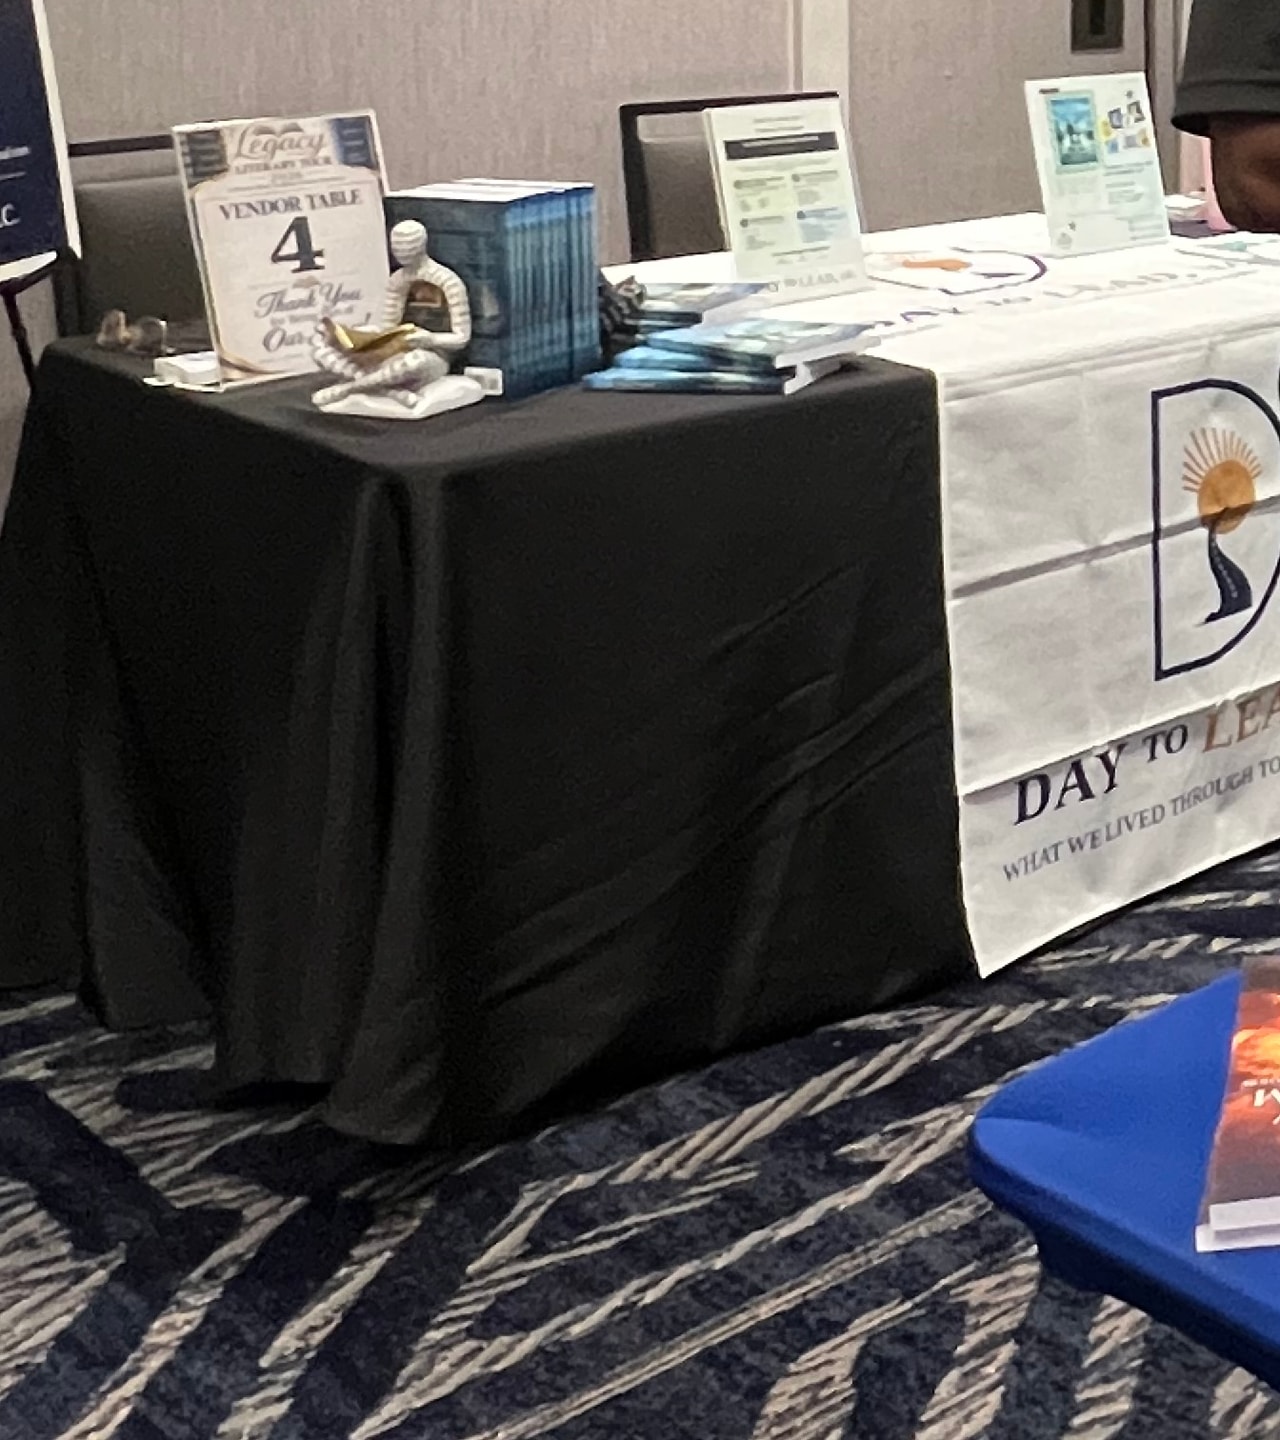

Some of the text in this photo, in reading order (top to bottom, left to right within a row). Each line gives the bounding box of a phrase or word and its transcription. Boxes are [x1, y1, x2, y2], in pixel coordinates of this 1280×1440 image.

[218, 188, 364, 221] VENDOR TABLE
[270, 215, 326, 274] 4
[254, 288, 316, 319] Thank
[319, 282, 362, 307] You
[1013, 742, 1128, 827] DAY
[1141, 724, 1189, 763] TO
[1002, 841, 1064, 882] WHAT
[1067, 827, 1101, 854] WE
[1104, 805, 1166, 842] LIVED
[1169, 769, 1255, 818] THROUGH
